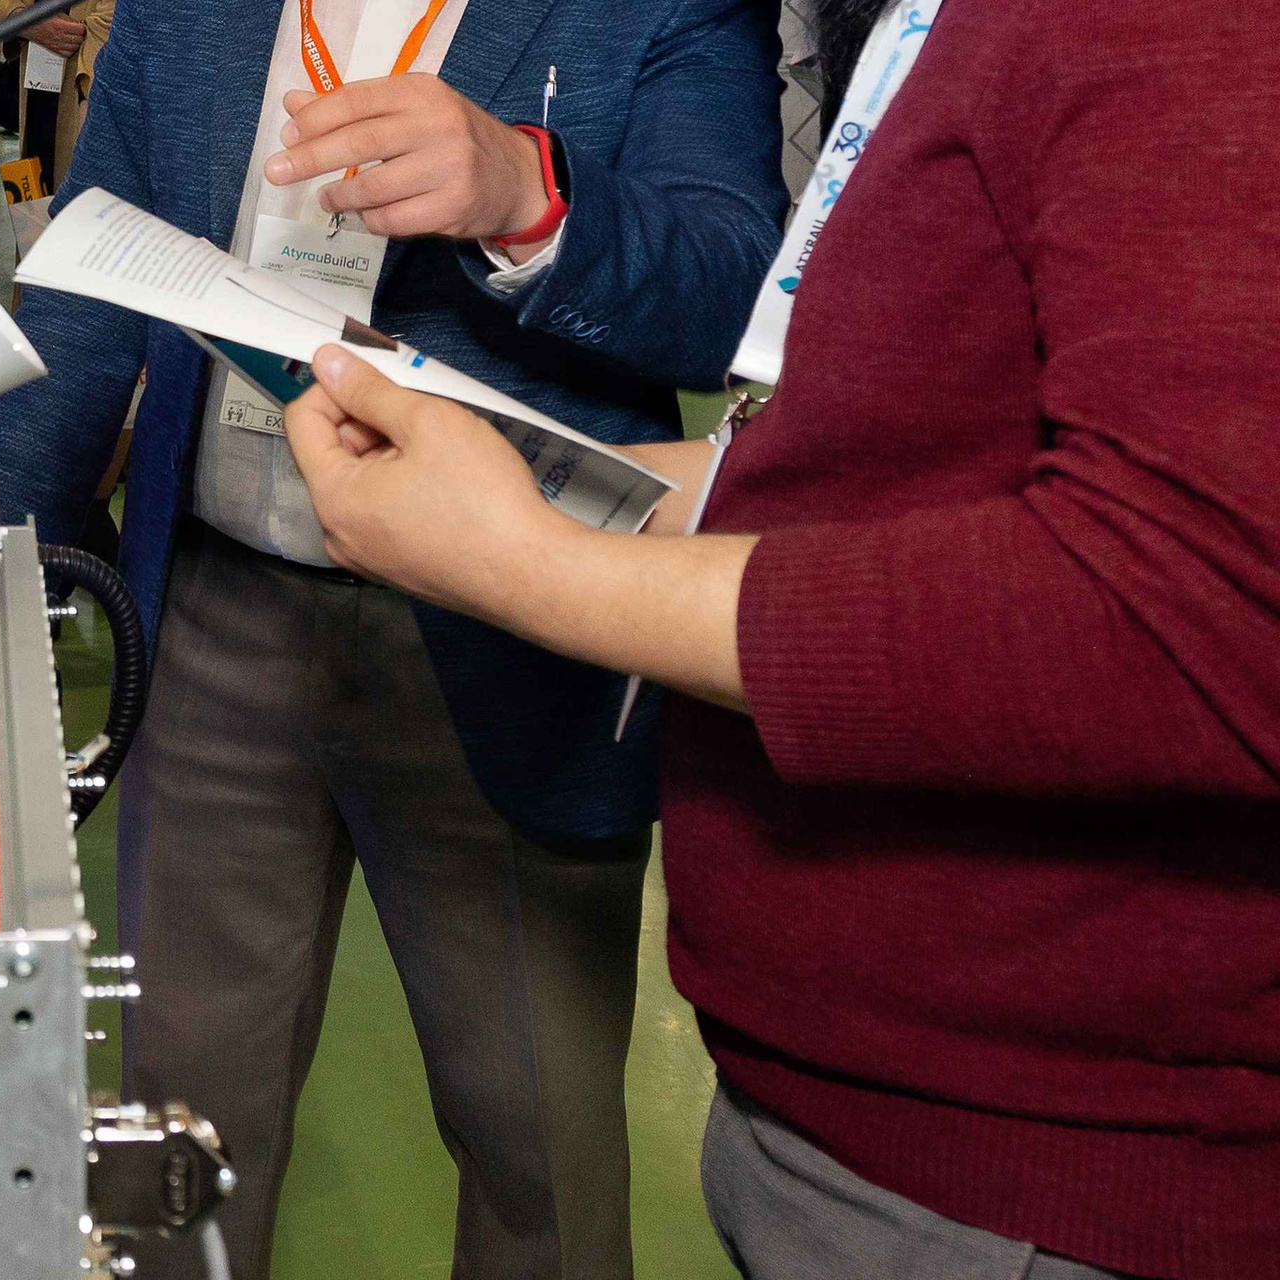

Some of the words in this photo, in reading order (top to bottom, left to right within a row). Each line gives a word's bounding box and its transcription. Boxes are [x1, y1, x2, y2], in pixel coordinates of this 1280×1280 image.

[21, 174, 33, 202] TOLS
[281, 245, 356, 271] AtyrauBuild
[795, 218, 826, 276] ATYRAU
[265, 414, 282, 428] EX
